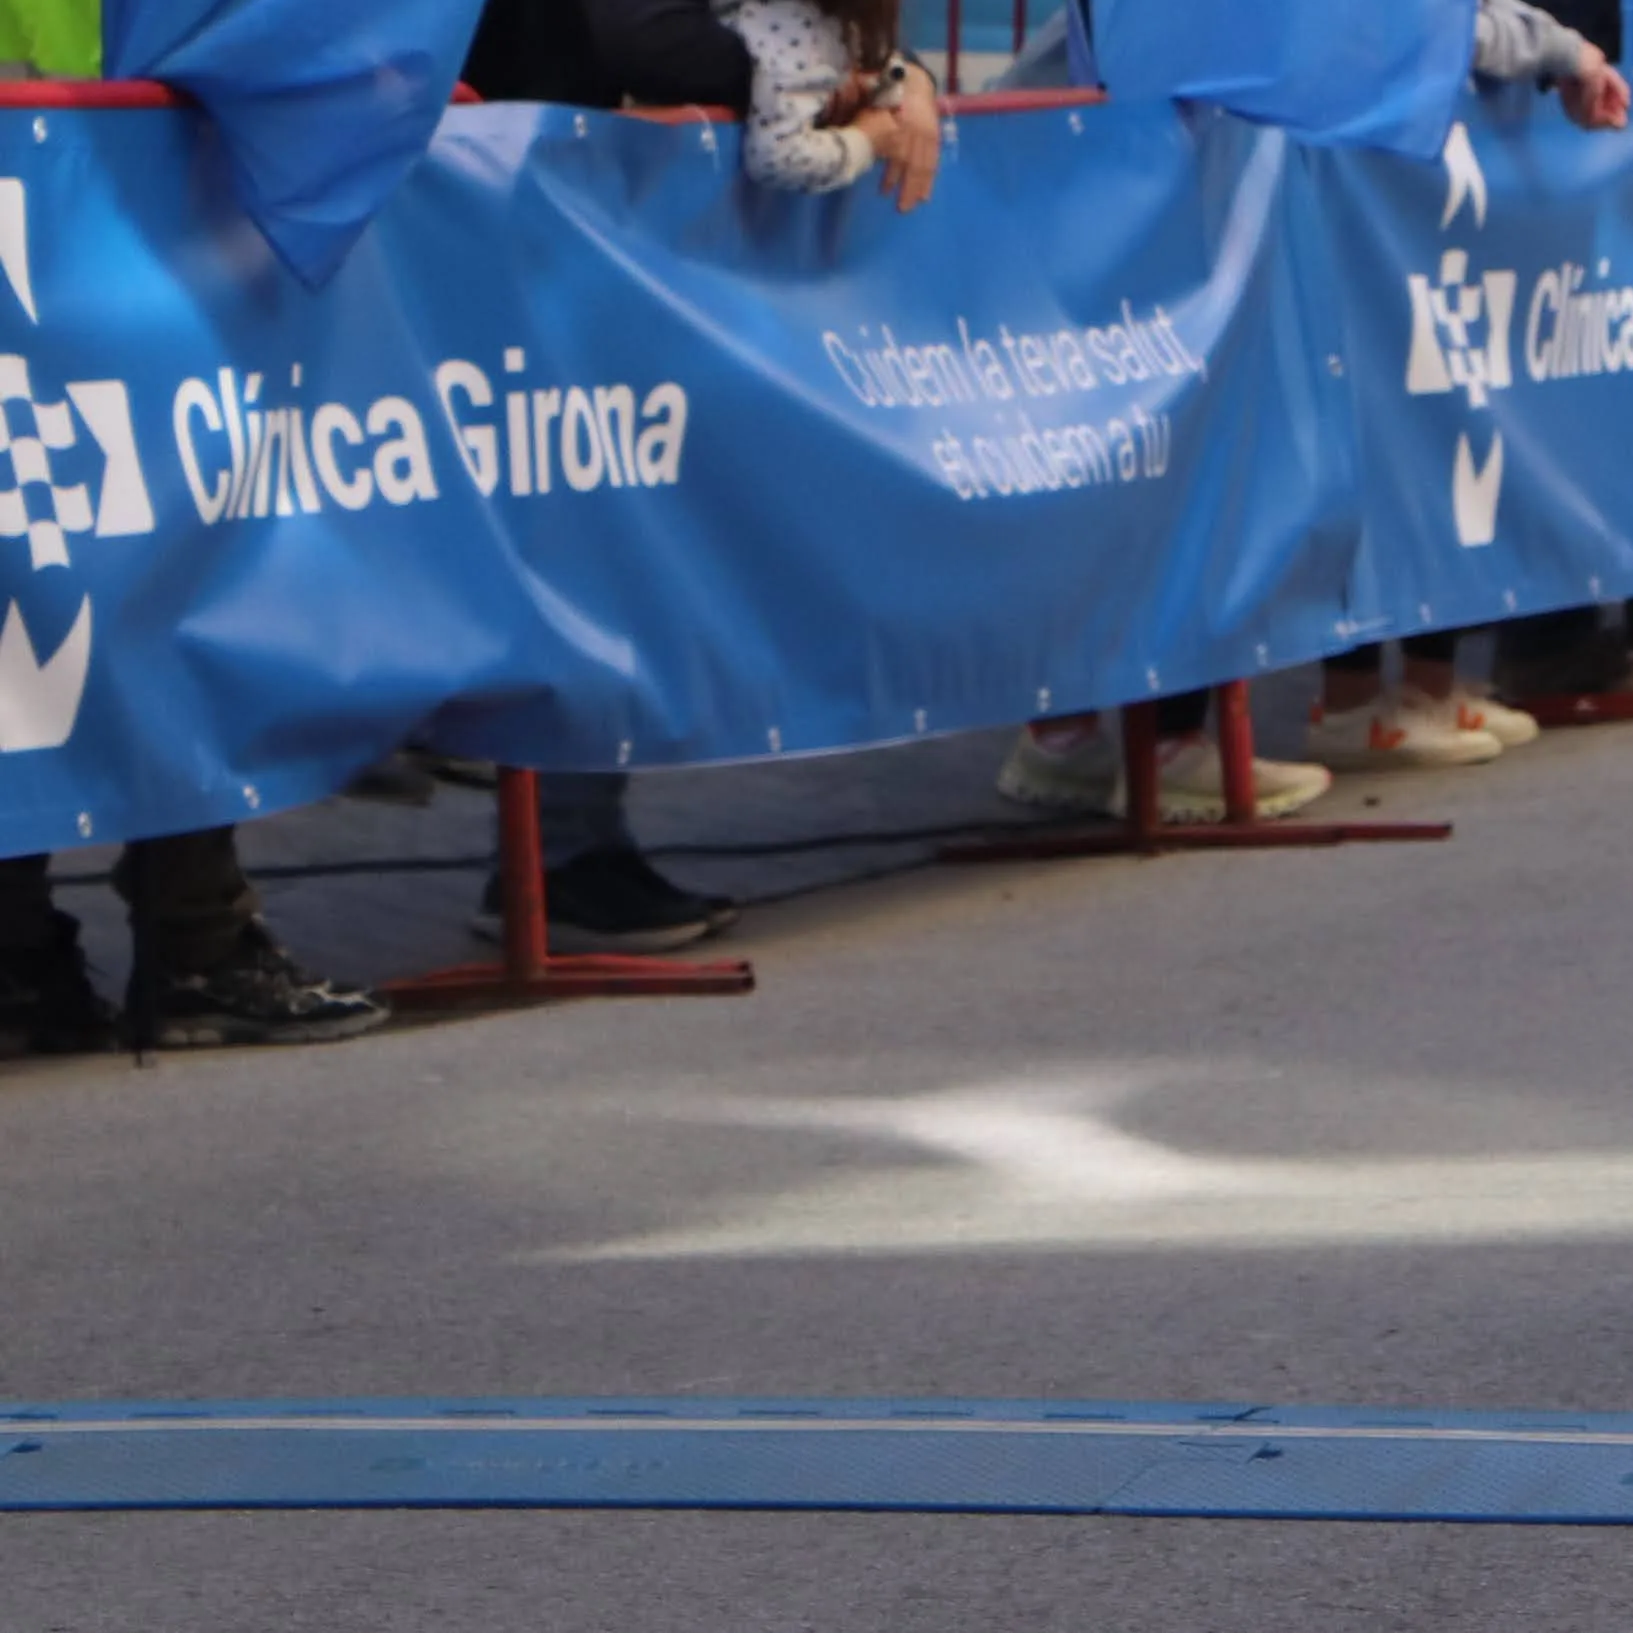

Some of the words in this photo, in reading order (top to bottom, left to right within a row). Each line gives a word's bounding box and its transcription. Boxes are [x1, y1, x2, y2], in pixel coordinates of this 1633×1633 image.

[823, 321, 977, 408] Cuidem
[957, 315, 1014, 400] la
[1000, 323, 1096, 396] teva
[173, 361, 439, 525] Clínica
[434, 347, 689, 498] Girona
[1107, 417, 1135, 482] a
